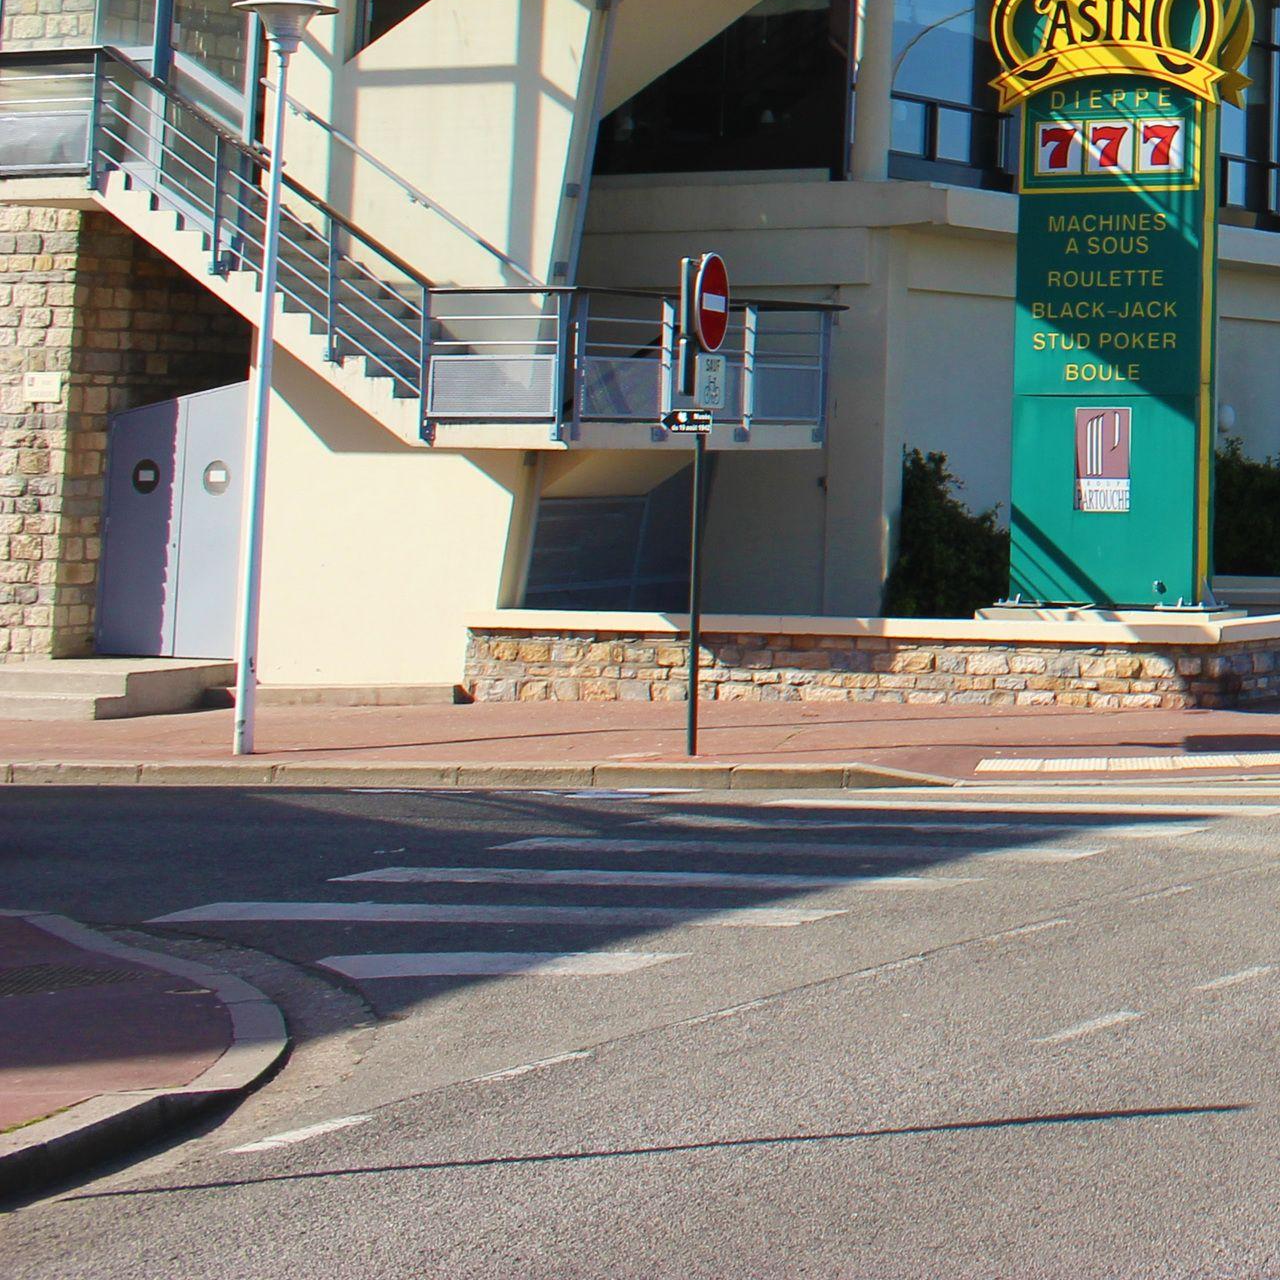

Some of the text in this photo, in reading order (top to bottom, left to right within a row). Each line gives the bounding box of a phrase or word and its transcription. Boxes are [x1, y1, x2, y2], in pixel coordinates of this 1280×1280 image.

[1051, 87, 1172, 111] DIEPPE
[1047, 212, 1168, 232] MACHINES
[1065, 235, 1150, 255] A SOUS
[1047, 269, 1165, 288] ROULETTE
[1032, 301, 1178, 320] BLACK-JACK
[1033, 331, 1177, 352] STUD POKER
[1065, 363, 1141, 382] BOULE
[1076, 489, 1131, 511] PARTOUCHE
